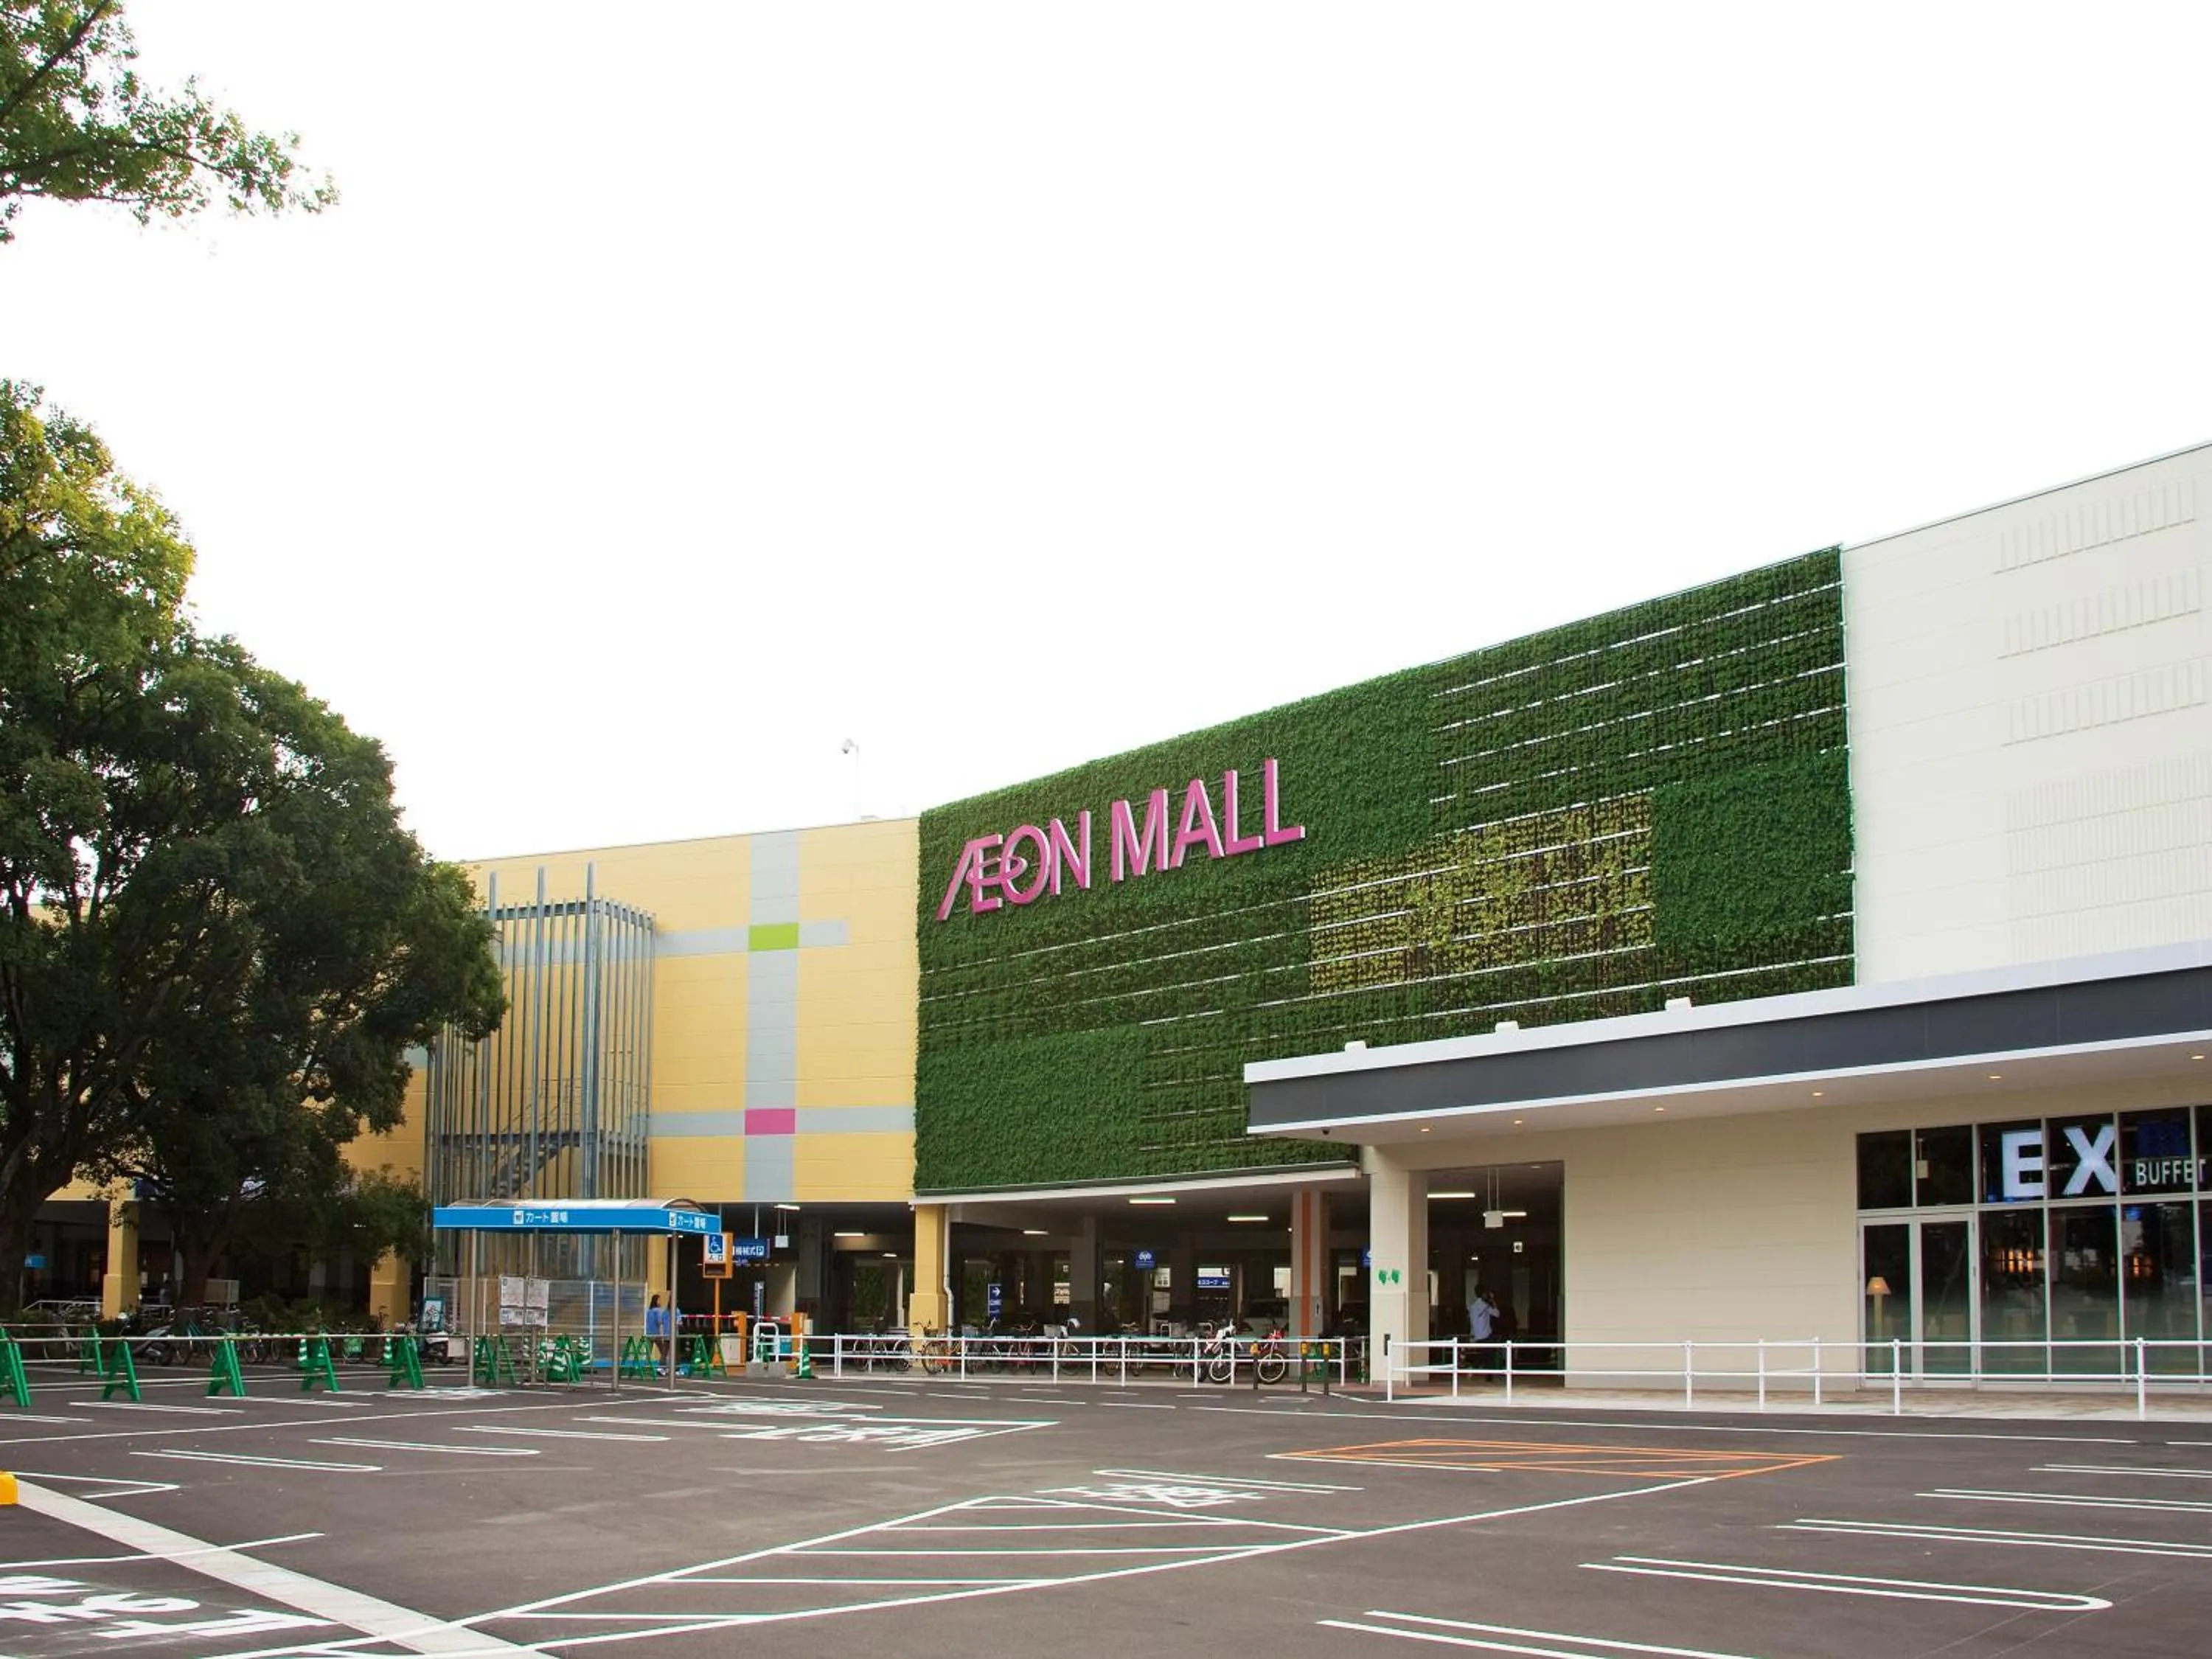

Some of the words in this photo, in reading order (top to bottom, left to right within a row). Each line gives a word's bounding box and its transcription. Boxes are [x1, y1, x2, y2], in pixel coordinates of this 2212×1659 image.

[1111, 757, 1306, 884] MALL
[2135, 1158, 2207, 1186] BUFFET
[526, 1211, 568, 1224] カート置場
